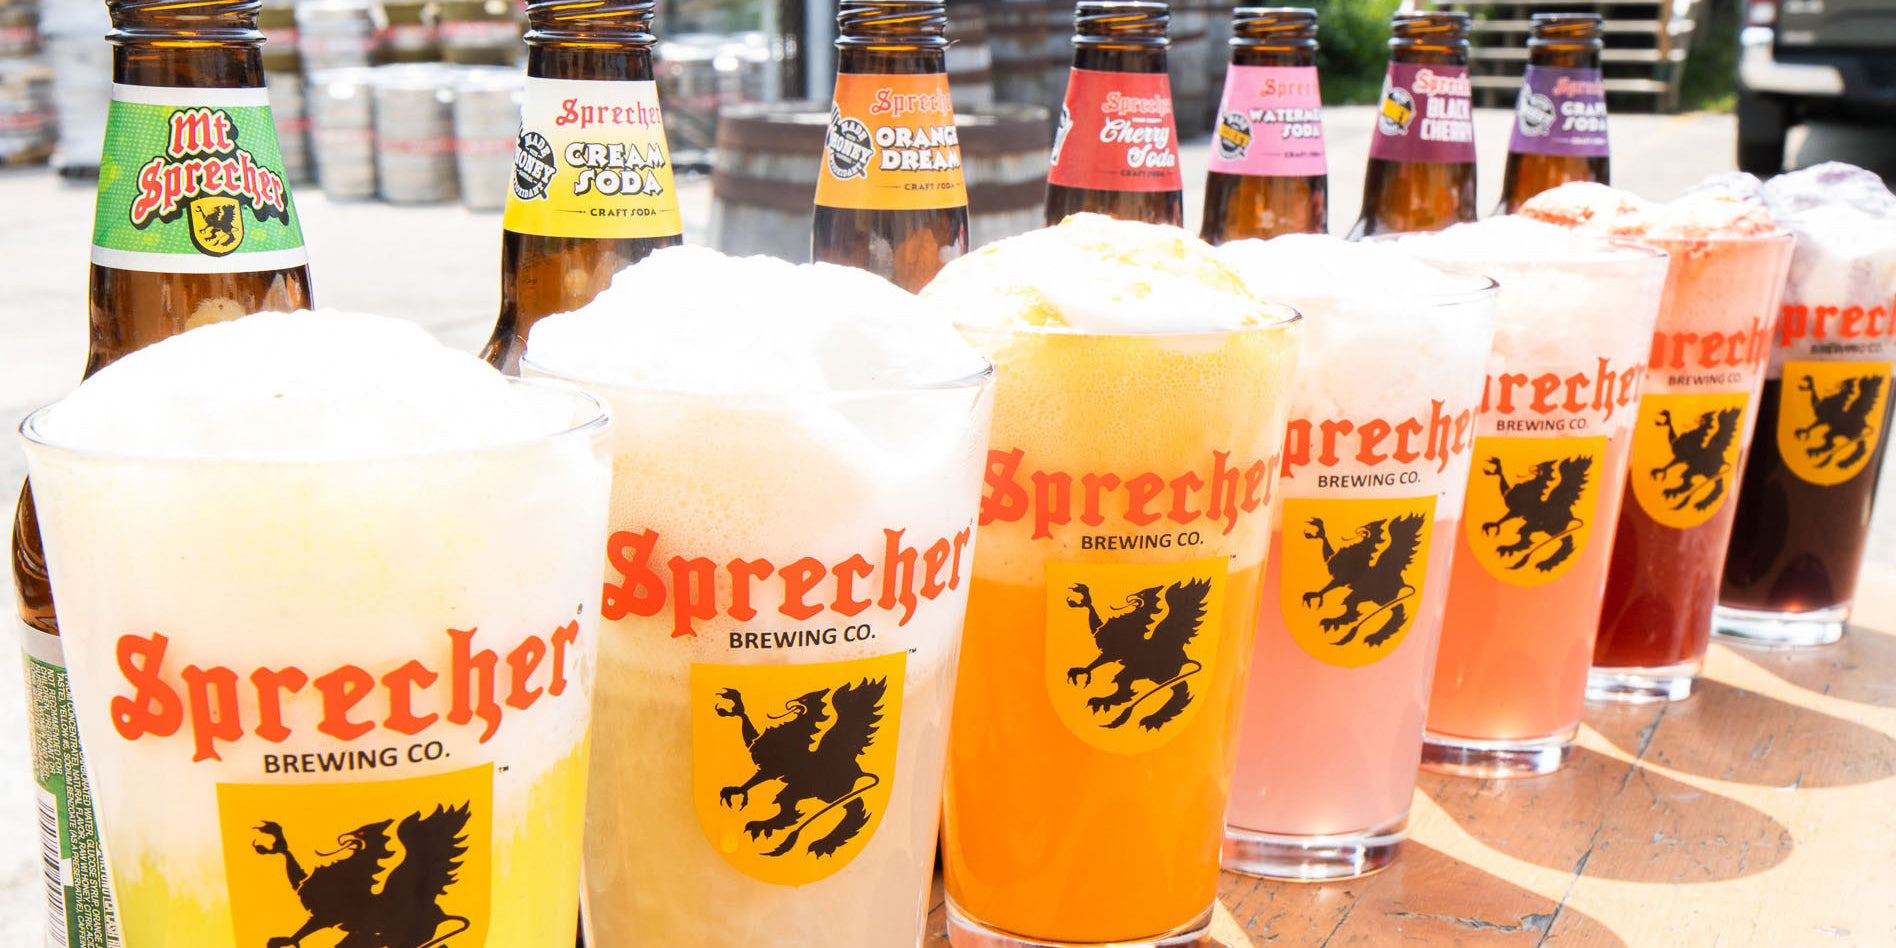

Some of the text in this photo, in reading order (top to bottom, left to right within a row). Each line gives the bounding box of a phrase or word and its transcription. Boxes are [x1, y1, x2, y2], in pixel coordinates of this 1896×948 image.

[168, 108, 234, 158] Mt
[1099, 116, 1170, 149] Cherry
[564, 141, 666, 170] CREAM
[880, 149, 960, 171] DREAM
[1126, 145, 1175, 168] Soda
[130, 148, 284, 224] Sprecher
[573, 169, 664, 197] SODA
[904, 183, 934, 191] CRAFT
[590, 207, 657, 217] CRAFT SODA
[1280, 398, 1481, 479] precher
[1496, 419, 1565, 431] BREWING
[977, 447, 1280, 540] Sprecher
[1317, 471, 1421, 488] BREWING CO.
[1081, 531, 1204, 551] BREWING CO.
[600, 525, 972, 638] Sprecher
[729, 623, 876, 649] BREWING CO.
[47, 669, 55, 687] NOT
[110, 618, 580, 763] Sprecher
[59, 704, 69, 738] YELLOW
[63, 752, 73, 785] SODIUM
[263, 740, 451, 774] BREWING CO.
[66, 786, 76, 828] BENZOATE
[72, 769, 83, 806] NATURAL
[79, 842, 87, 862] RAW
[84, 904, 93, 930] CITRIC
[86, 839, 96, 878] GLUCOSE
[92, 909, 102, 942] ORANGE
[78, 916, 86, 948] CAFFEIN
